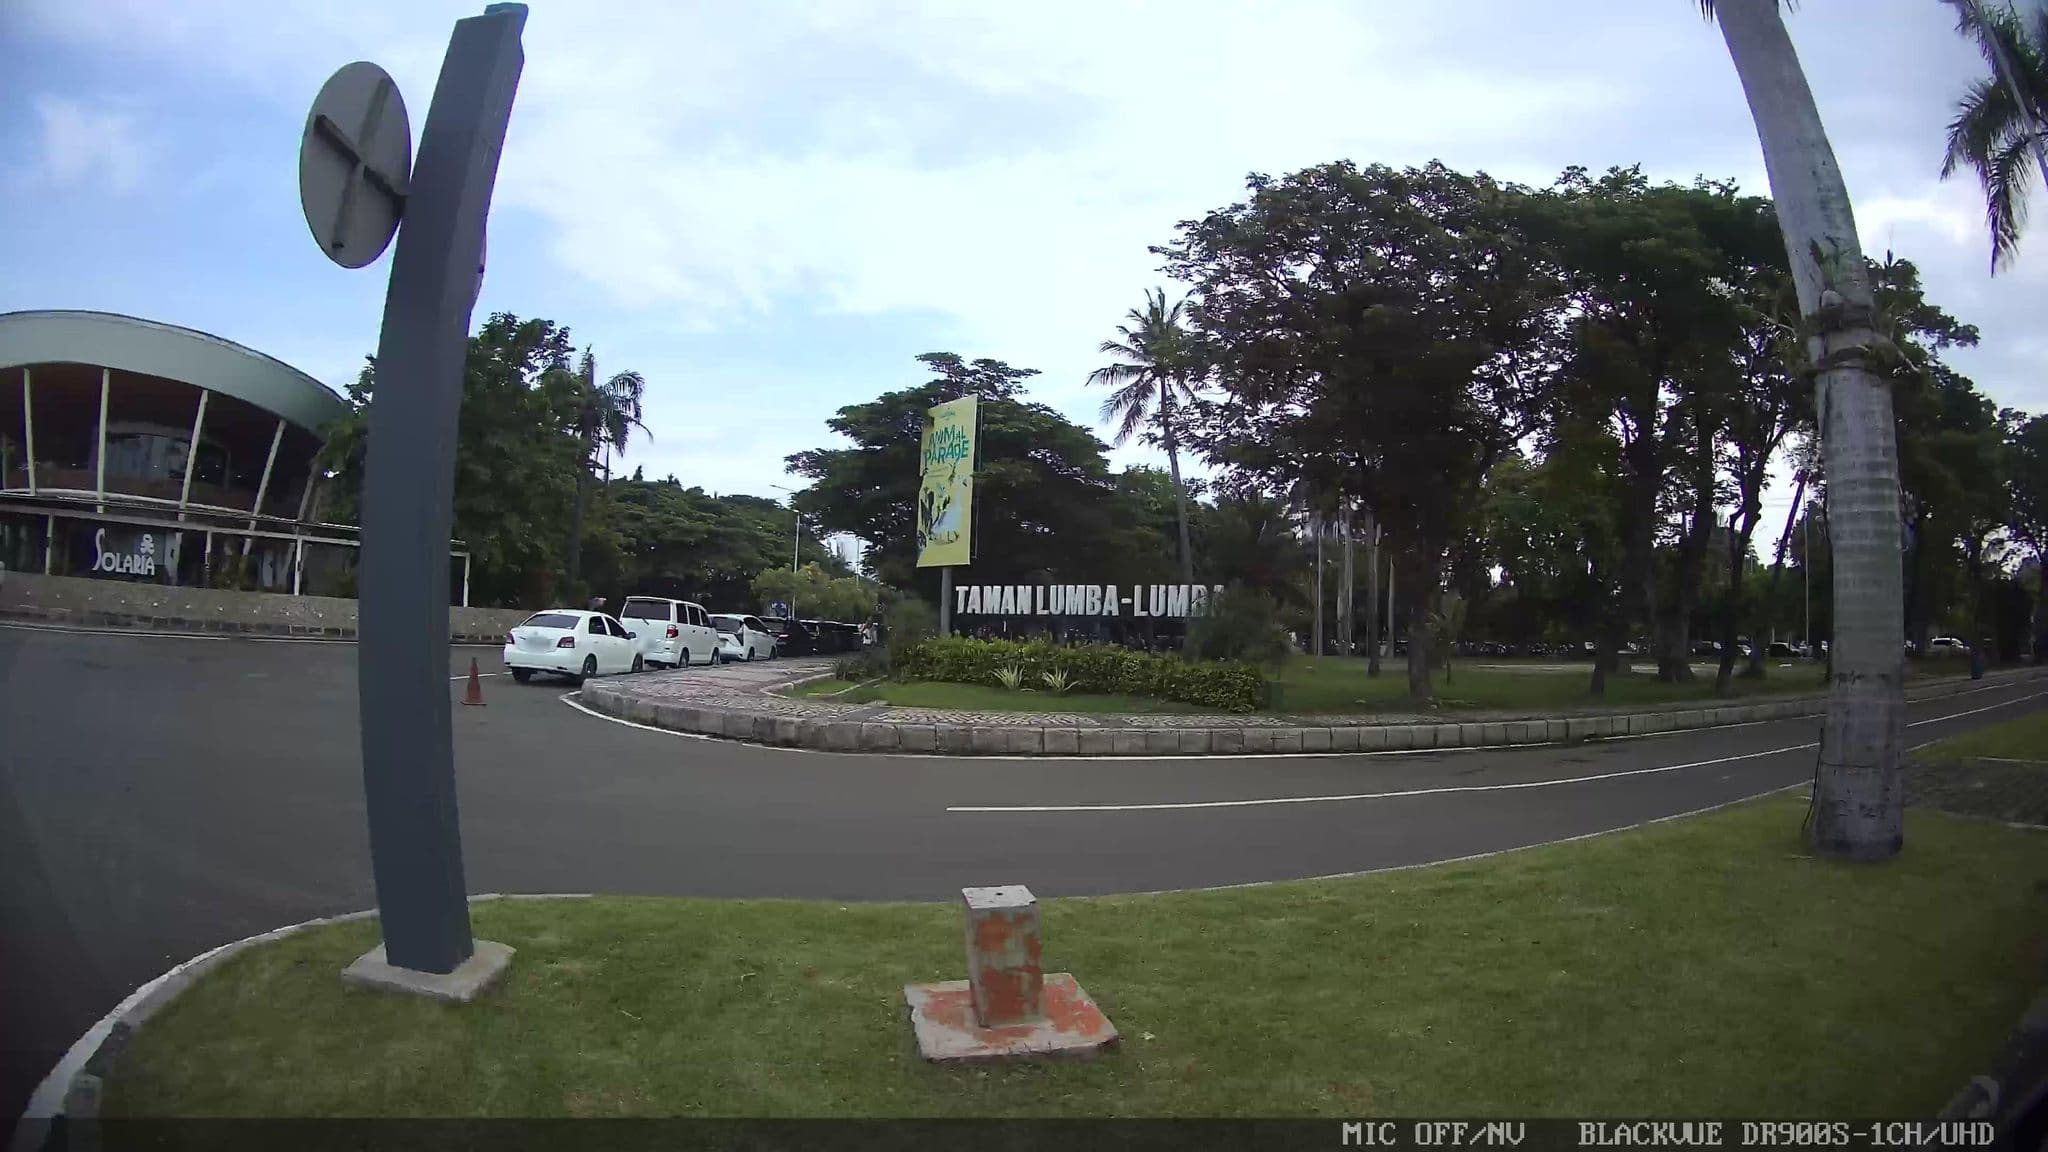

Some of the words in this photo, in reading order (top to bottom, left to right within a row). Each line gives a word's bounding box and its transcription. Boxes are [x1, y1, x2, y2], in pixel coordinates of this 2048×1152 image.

[924, 440, 969, 467] PARADE
[91, 528, 155, 576] SOLARIA
[955, 585, 1032, 615] TAMAN
